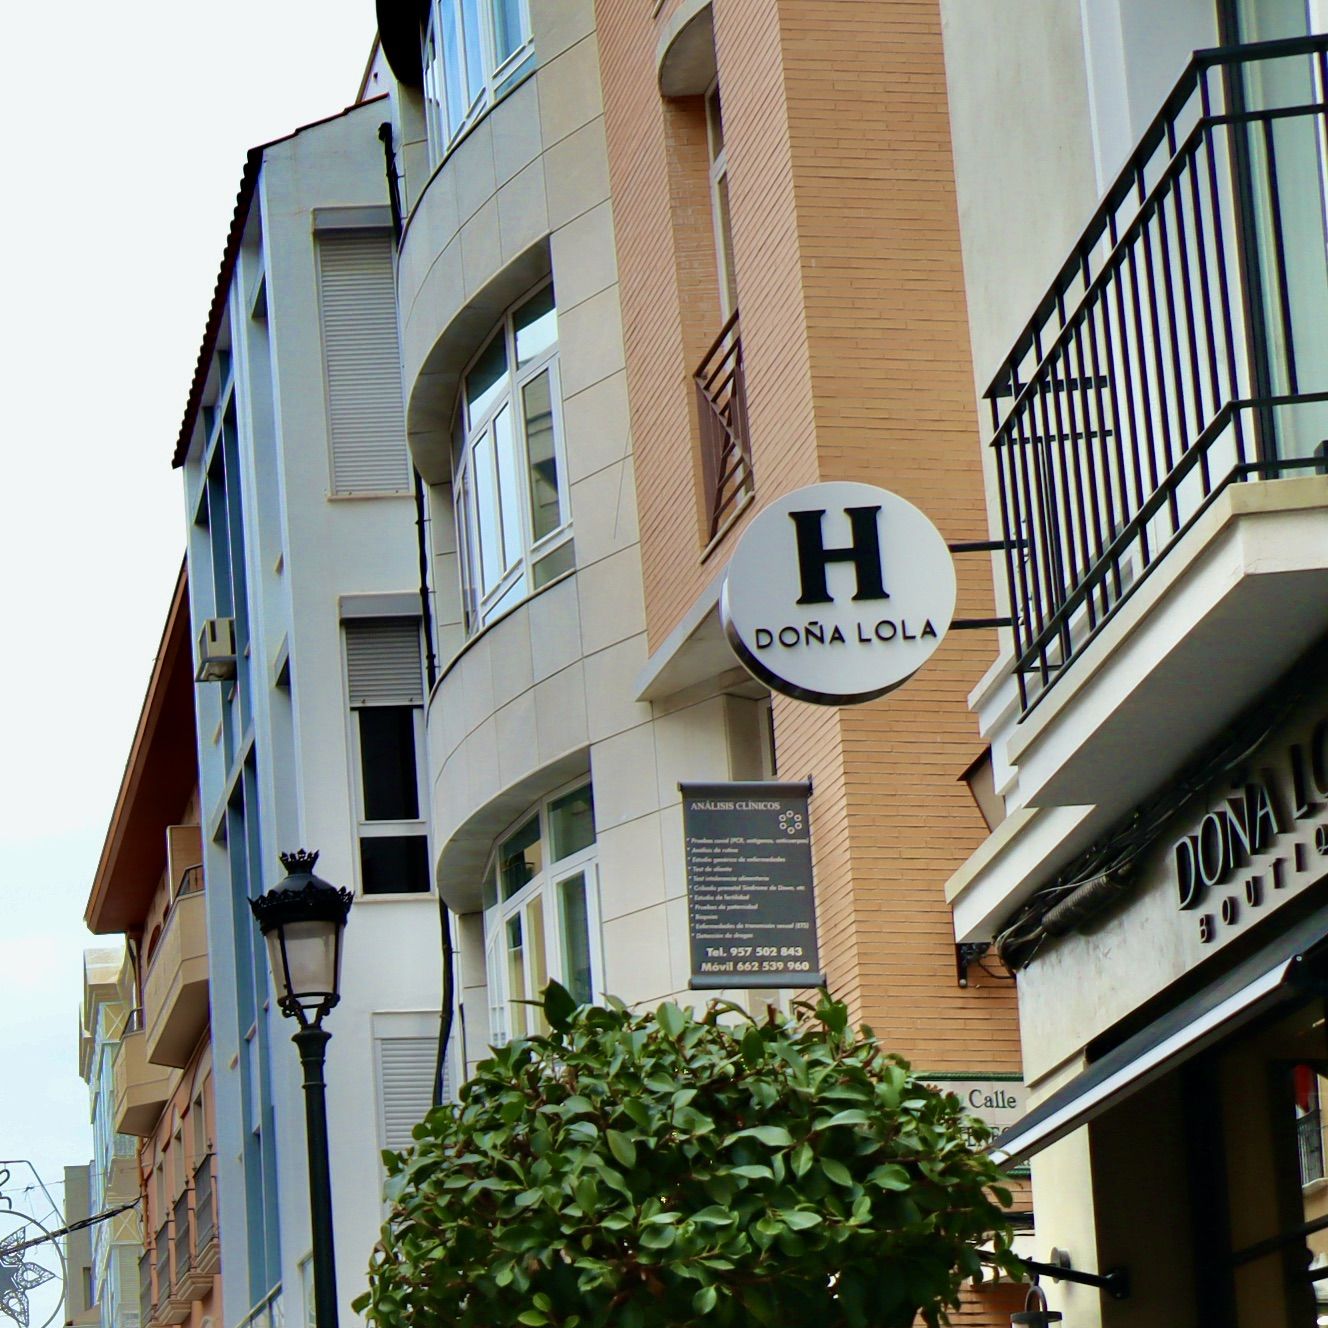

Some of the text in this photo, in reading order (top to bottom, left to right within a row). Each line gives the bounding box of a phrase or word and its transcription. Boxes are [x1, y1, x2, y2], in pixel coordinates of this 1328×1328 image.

[788, 505, 890, 604] H
[755, 619, 937, 649] DOÑA LOLA
[690, 799, 781, 811] ANÁLISIS CLÍNICOS
[706, 947, 803, 957] Tel. 957 502 843
[700, 961, 810, 971] Móvil 662 539 960
[968, 1089, 1017, 1109] Calle
